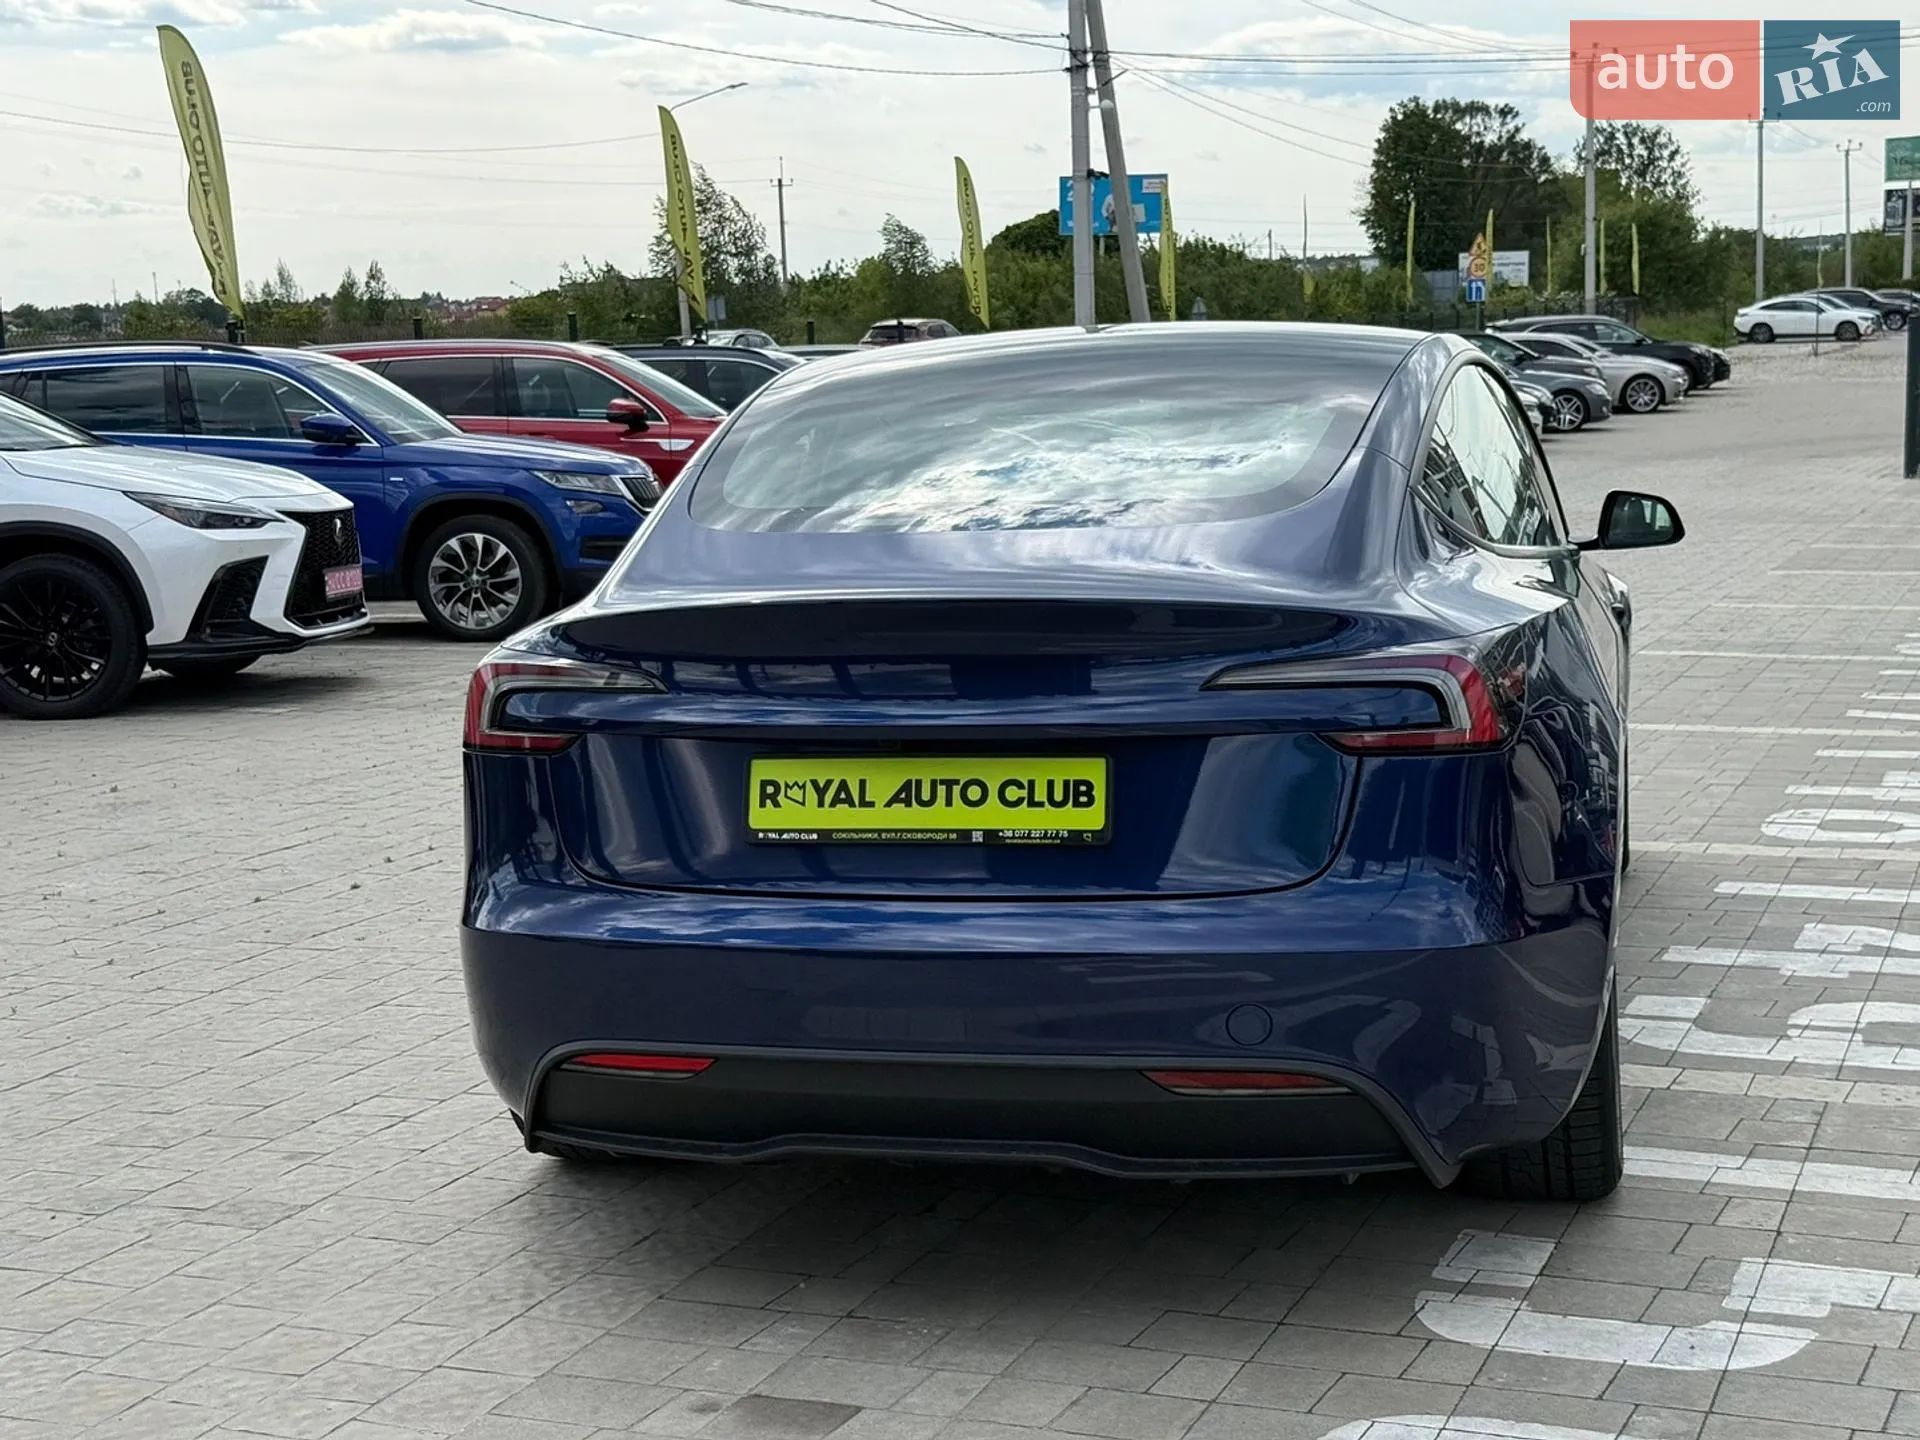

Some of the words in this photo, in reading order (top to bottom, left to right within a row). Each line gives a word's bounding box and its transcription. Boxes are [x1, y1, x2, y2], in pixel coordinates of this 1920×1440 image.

[1474, 263, 1486, 273] 30
[883, 778, 990, 809] AUTO
[997, 778, 1096, 809] CLUB
[801, 832, 819, 841] CLUB
